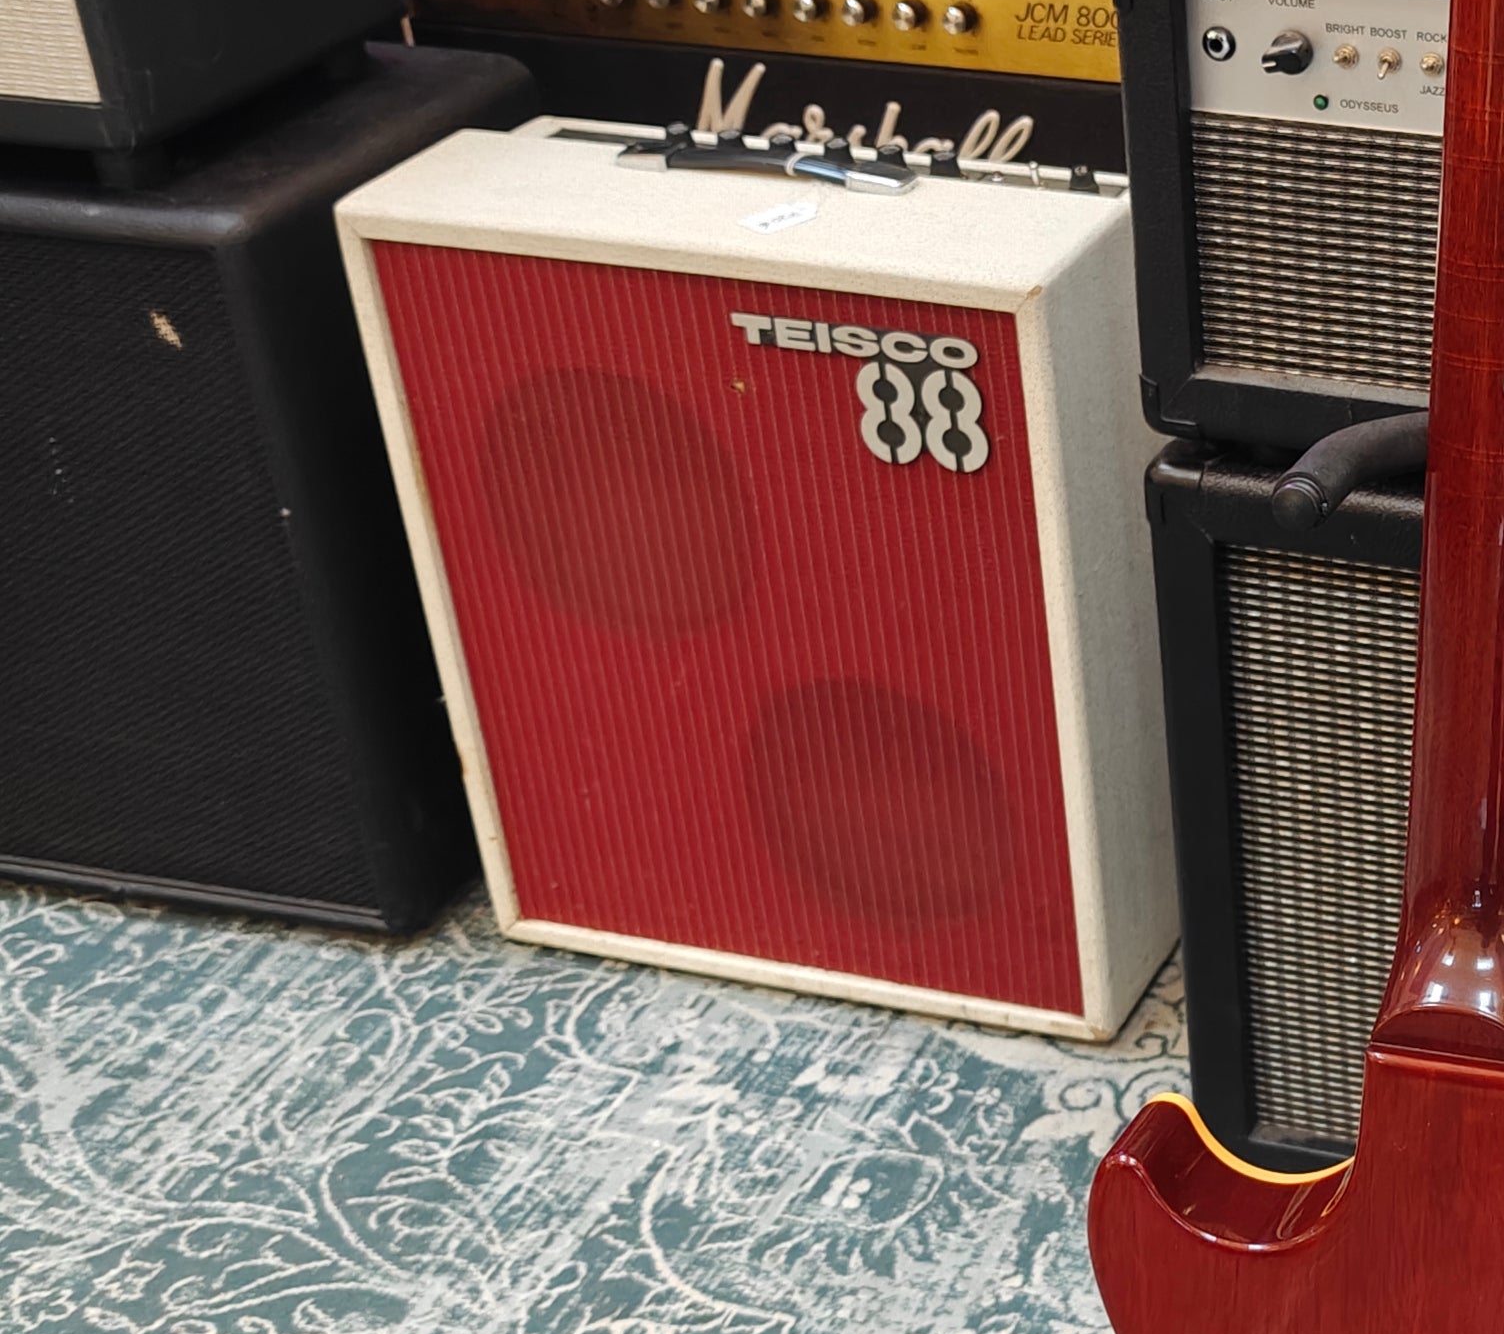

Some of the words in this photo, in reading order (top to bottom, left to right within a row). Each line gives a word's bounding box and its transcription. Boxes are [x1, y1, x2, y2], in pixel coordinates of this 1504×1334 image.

[1014, 2, 1069, 25] JCM
[1017, 25, 1067, 43] LEAD
[1070, 28, 1117, 48] SERIE
[1325, 22, 1366, 36] BRIGHT
[1370, 26, 1408, 40] BOOST
[1416, 31, 1447, 44] ROCK
[1419, 85, 1446, 97] JAZZ
[1340, 98, 1399, 114] ODYSSEUS
[730, 312, 979, 370] TEISCO
[856, 361, 989, 474] 88
